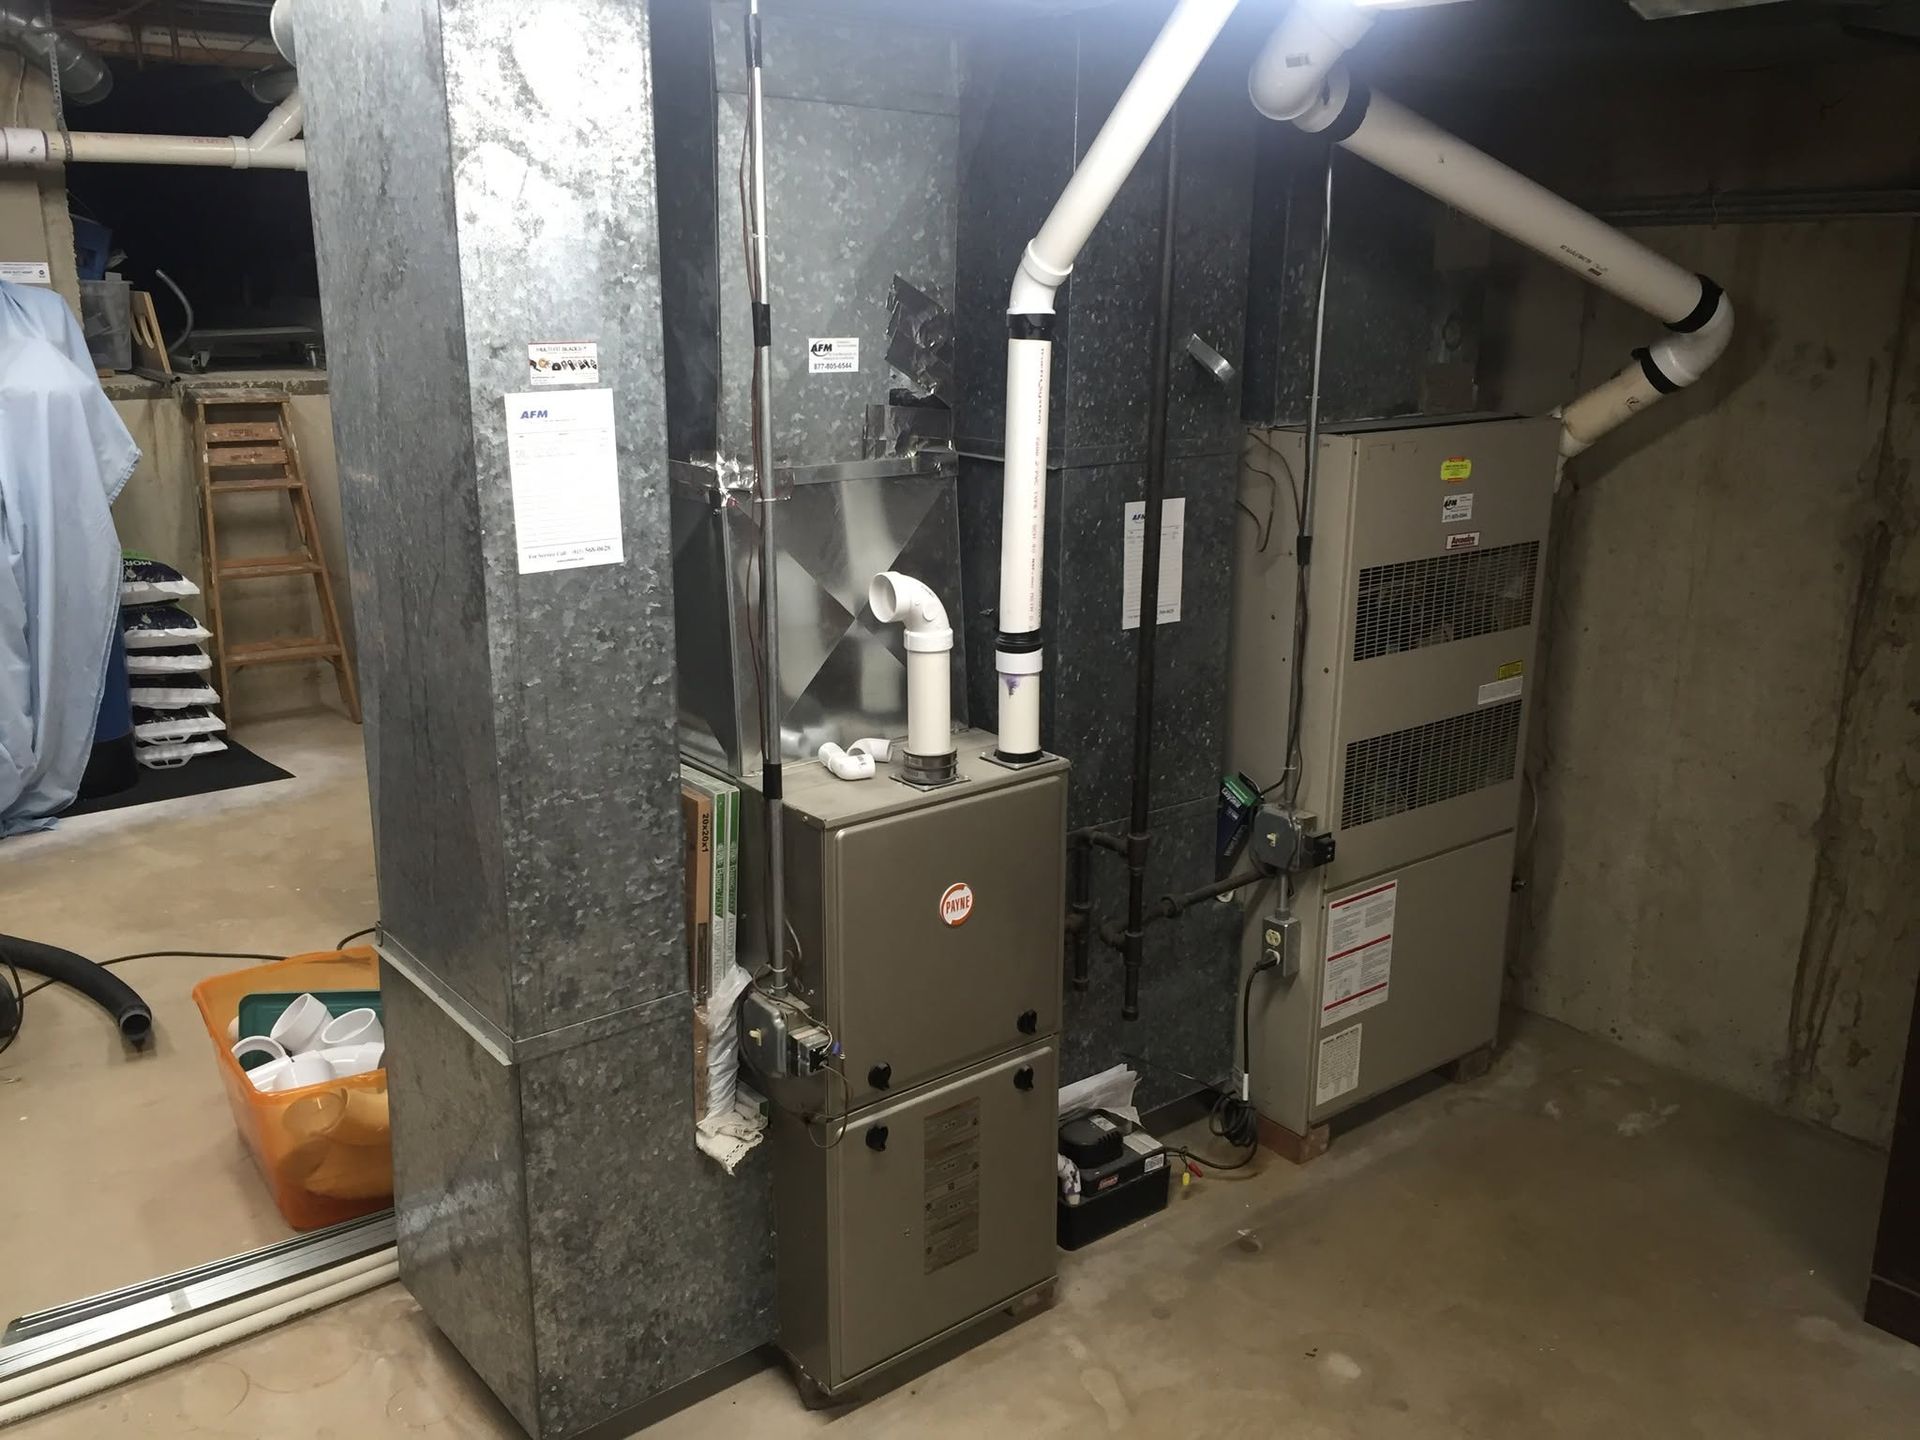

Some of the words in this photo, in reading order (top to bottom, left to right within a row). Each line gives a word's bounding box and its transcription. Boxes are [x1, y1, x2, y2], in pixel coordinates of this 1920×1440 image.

[810, 343, 833, 353] AFM
[520, 409, 549, 420] AFM
[701, 813, 710, 853] 20x20x1
[946, 895, 971, 914] PAYNE
